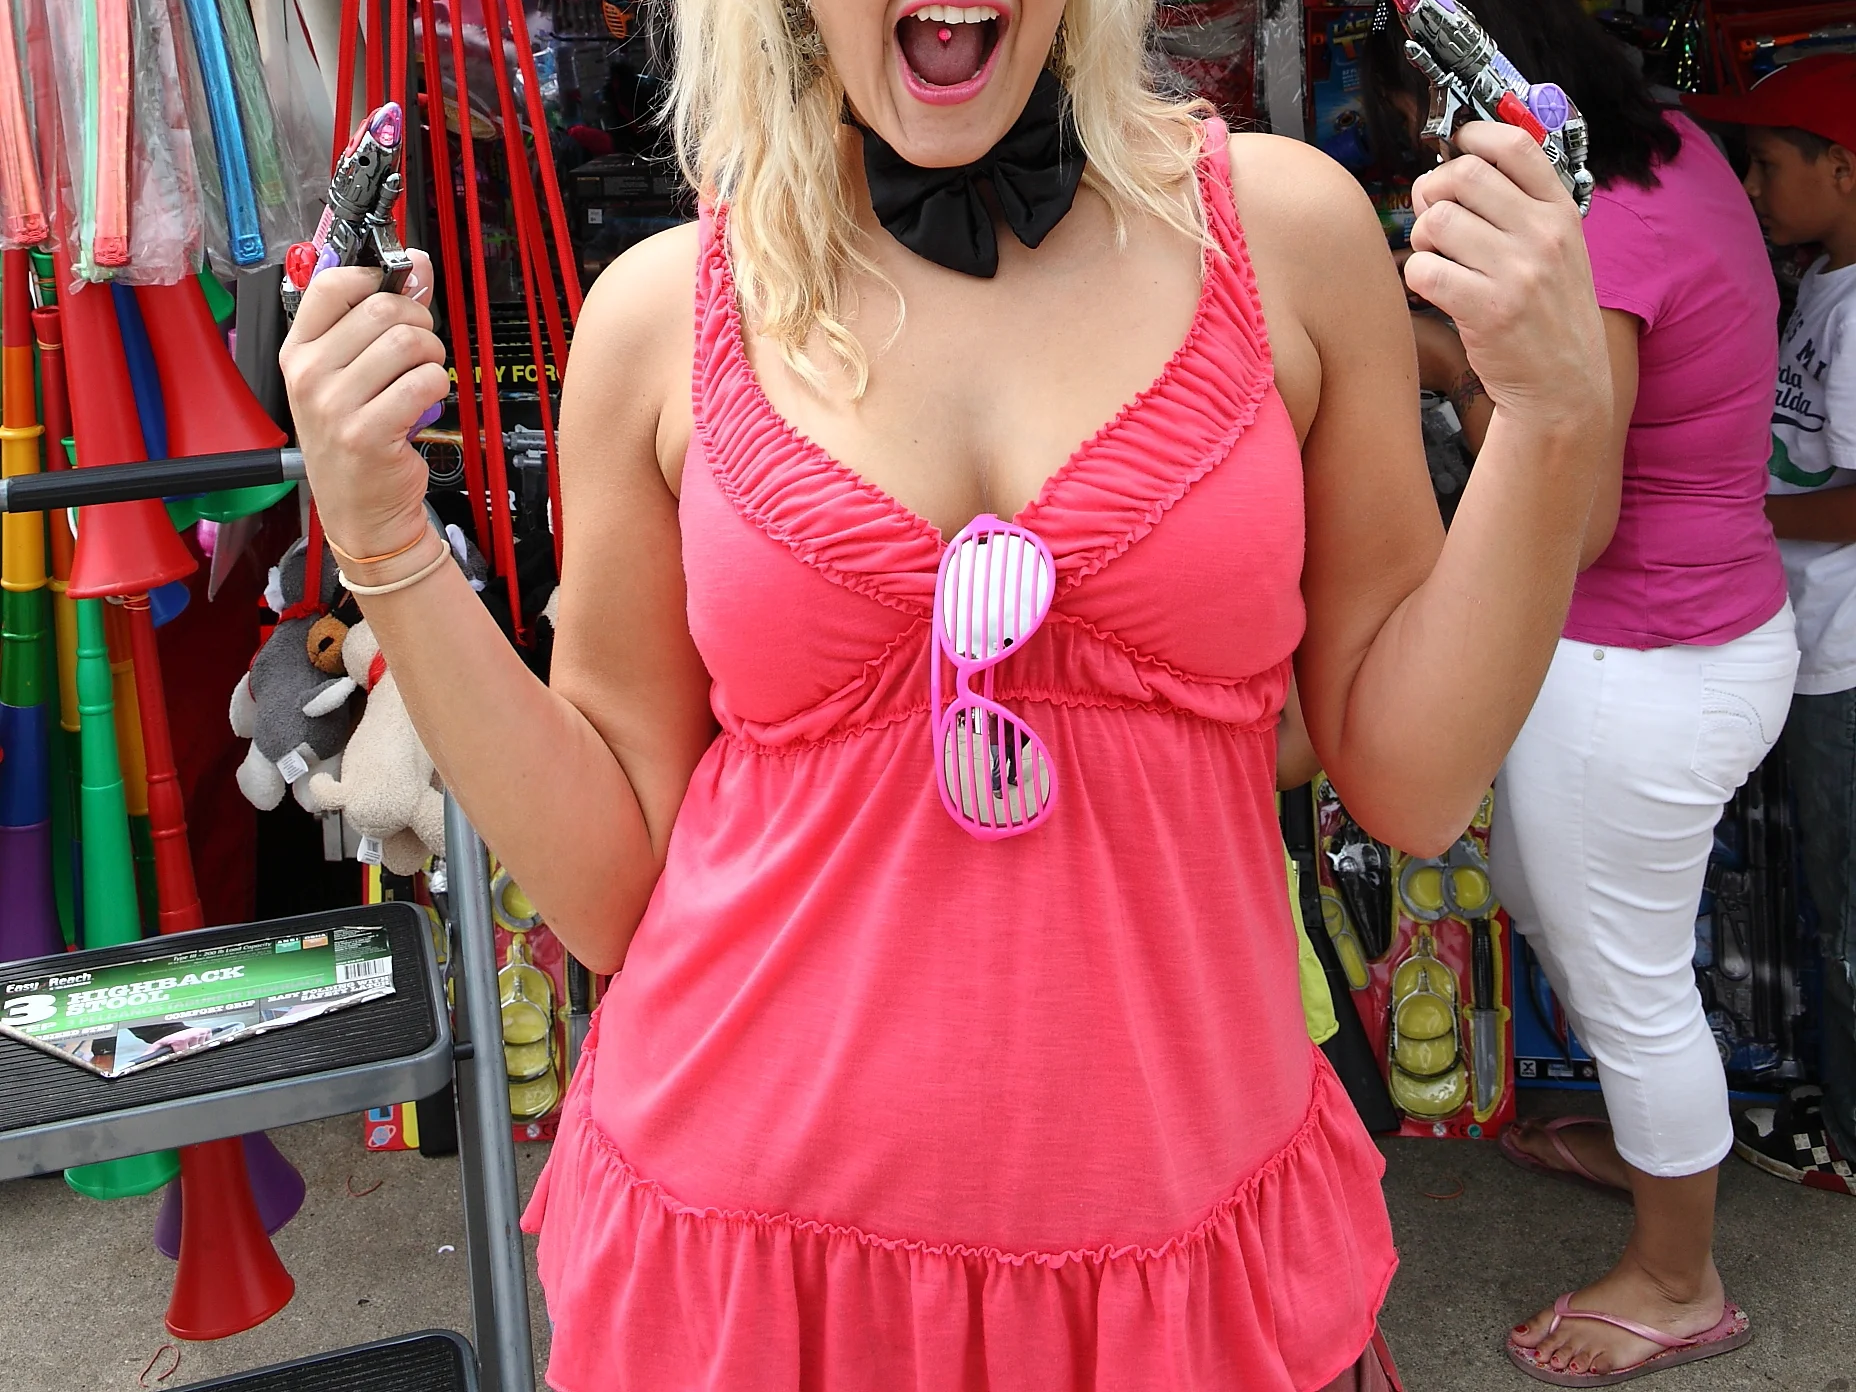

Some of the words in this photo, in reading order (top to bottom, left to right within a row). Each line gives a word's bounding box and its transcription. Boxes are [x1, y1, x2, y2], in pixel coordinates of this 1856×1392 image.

[512, 365, 561, 382] FOR
[1778, 365, 1802, 389] da
[243, 942, 272, 951] Capacity
[6, 981, 39, 994] Easy
[48, 972, 92, 988] Reach
[66, 965, 245, 1006] HIGHBACK
[267, 991, 300, 1002] EASY
[301, 981, 355, 996] FOLDING
[356, 975, 390, 987] WITH
[300, 988, 349, 1001] SAFETY
[1, 994, 58, 1026] 3
[65, 989, 170, 1017] STOOL
[164, 1004, 224, 1021] COMFORT
[225, 999, 256, 1012] GRIP
